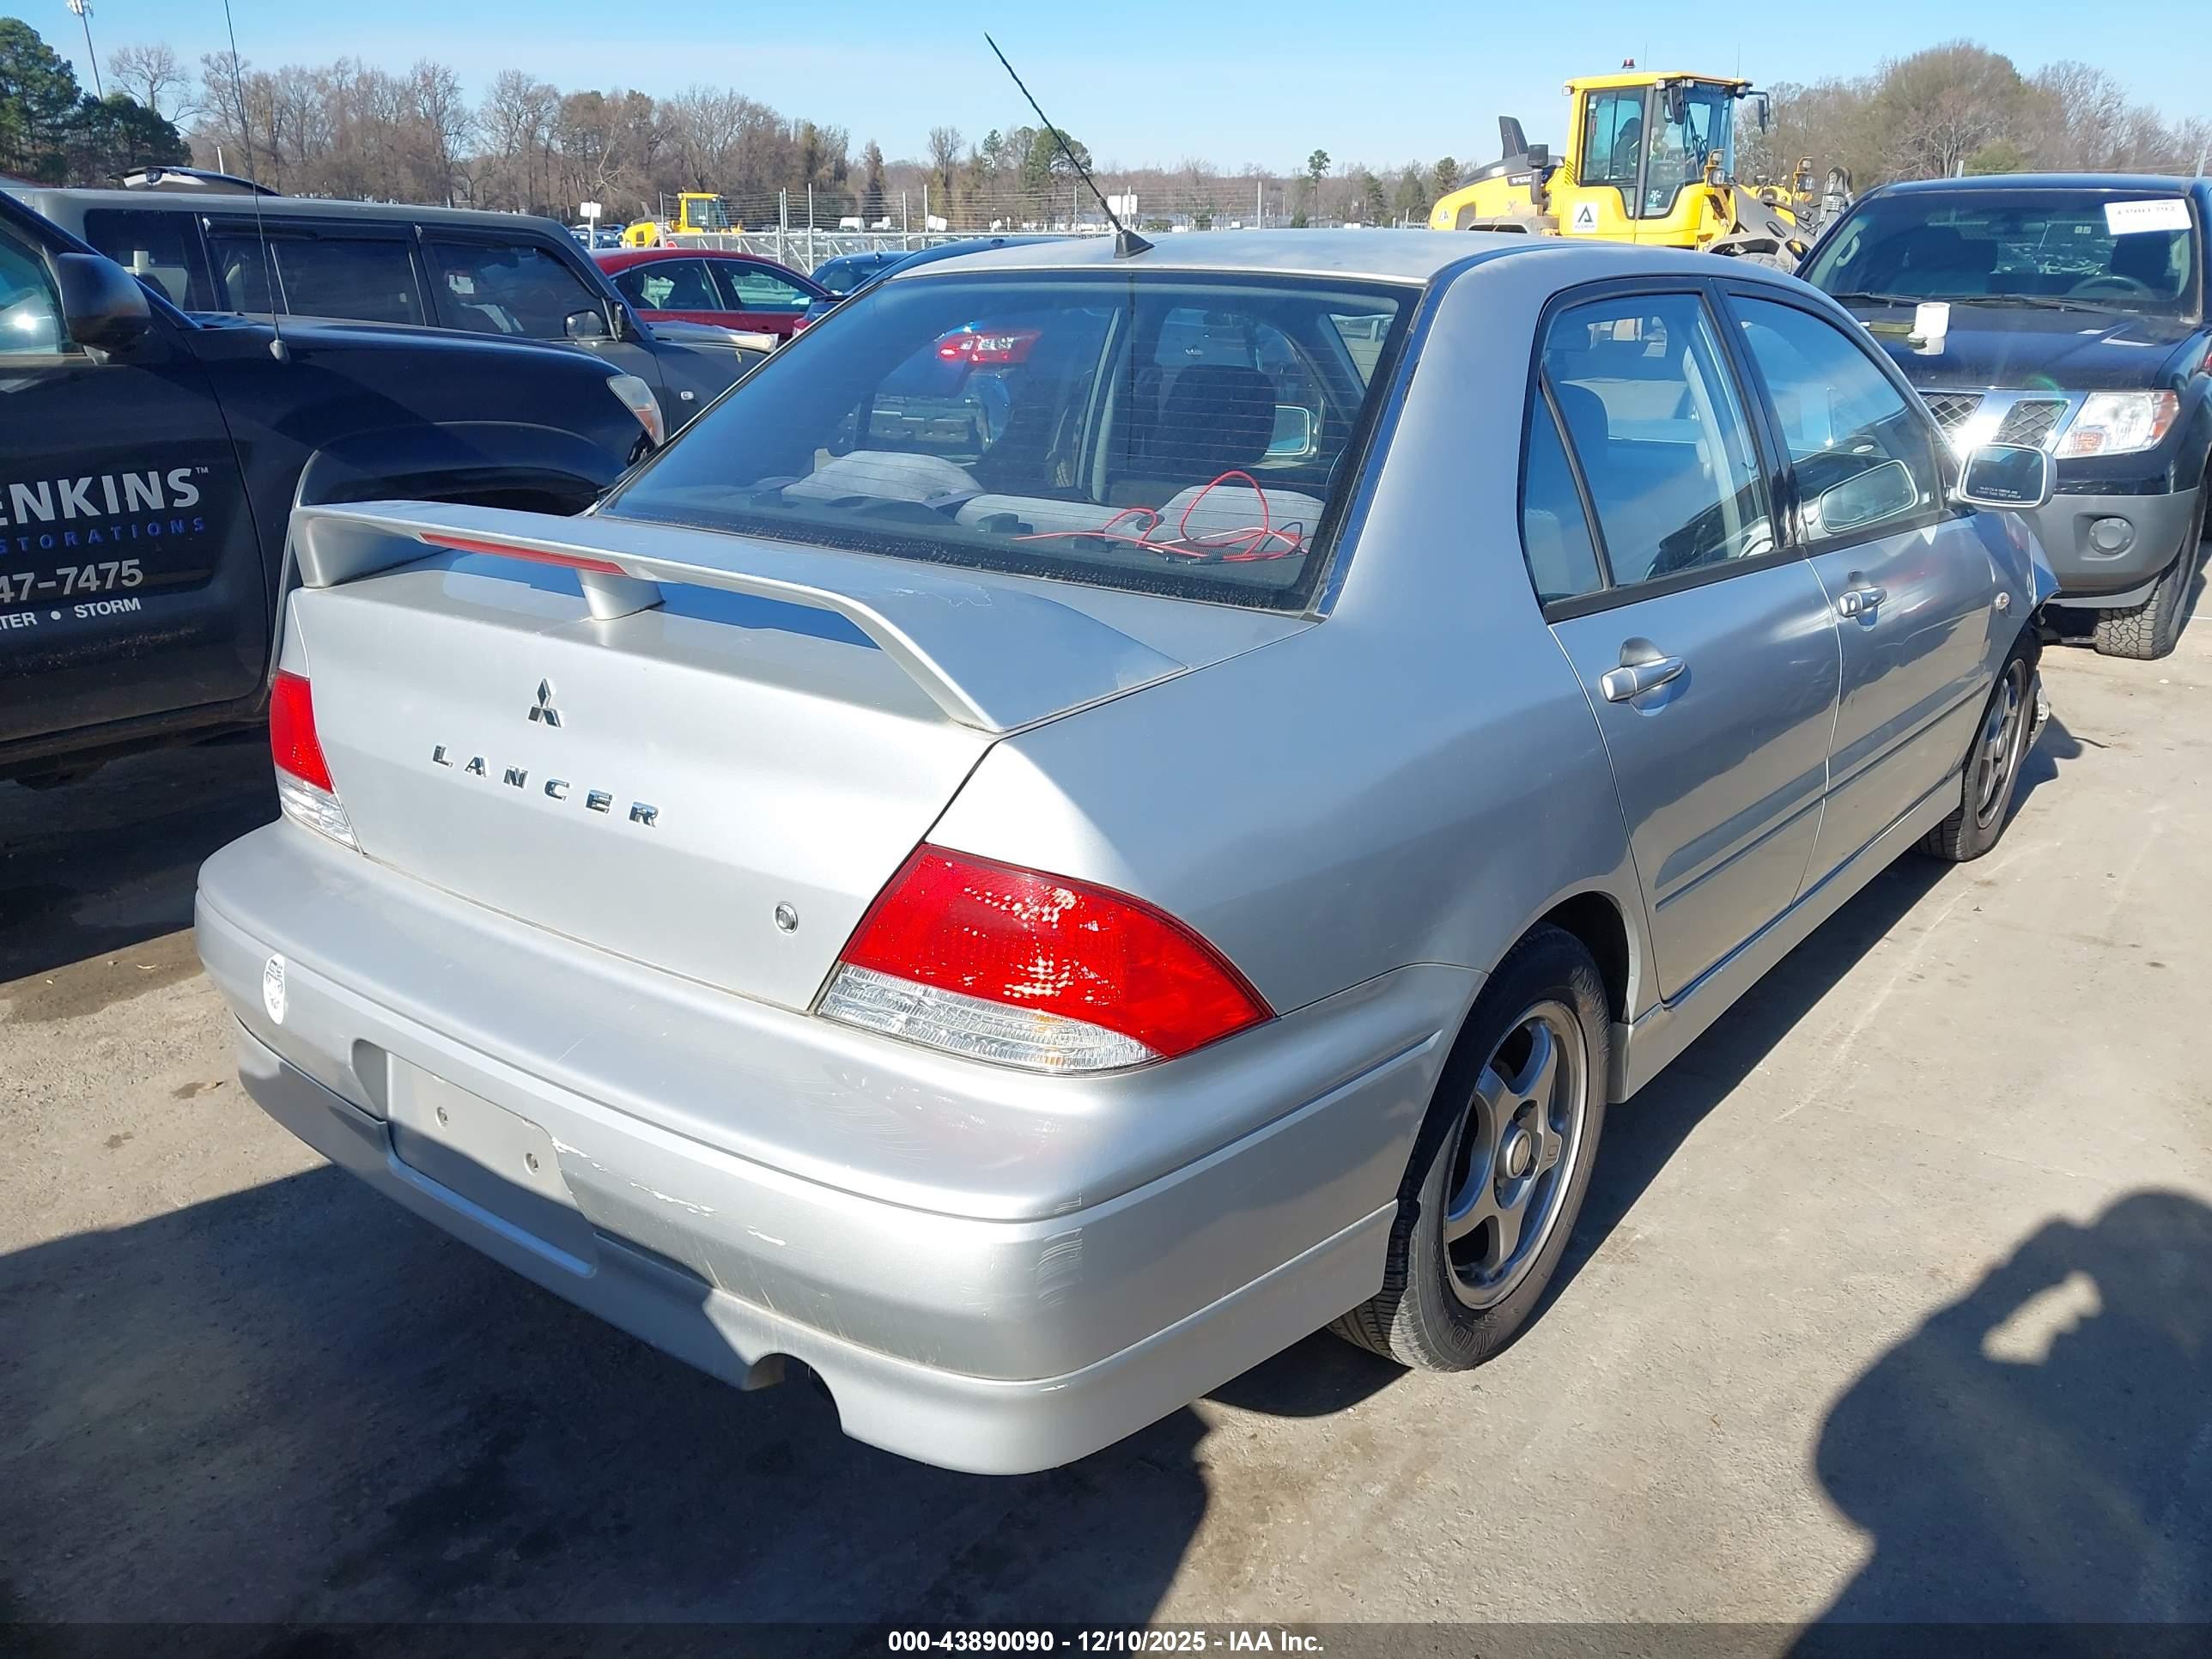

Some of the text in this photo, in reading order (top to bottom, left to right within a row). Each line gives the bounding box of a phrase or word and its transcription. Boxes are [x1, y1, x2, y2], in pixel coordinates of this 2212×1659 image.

[0, 598, 142, 630] TER STORM
[432, 744, 659, 828] LANCER
